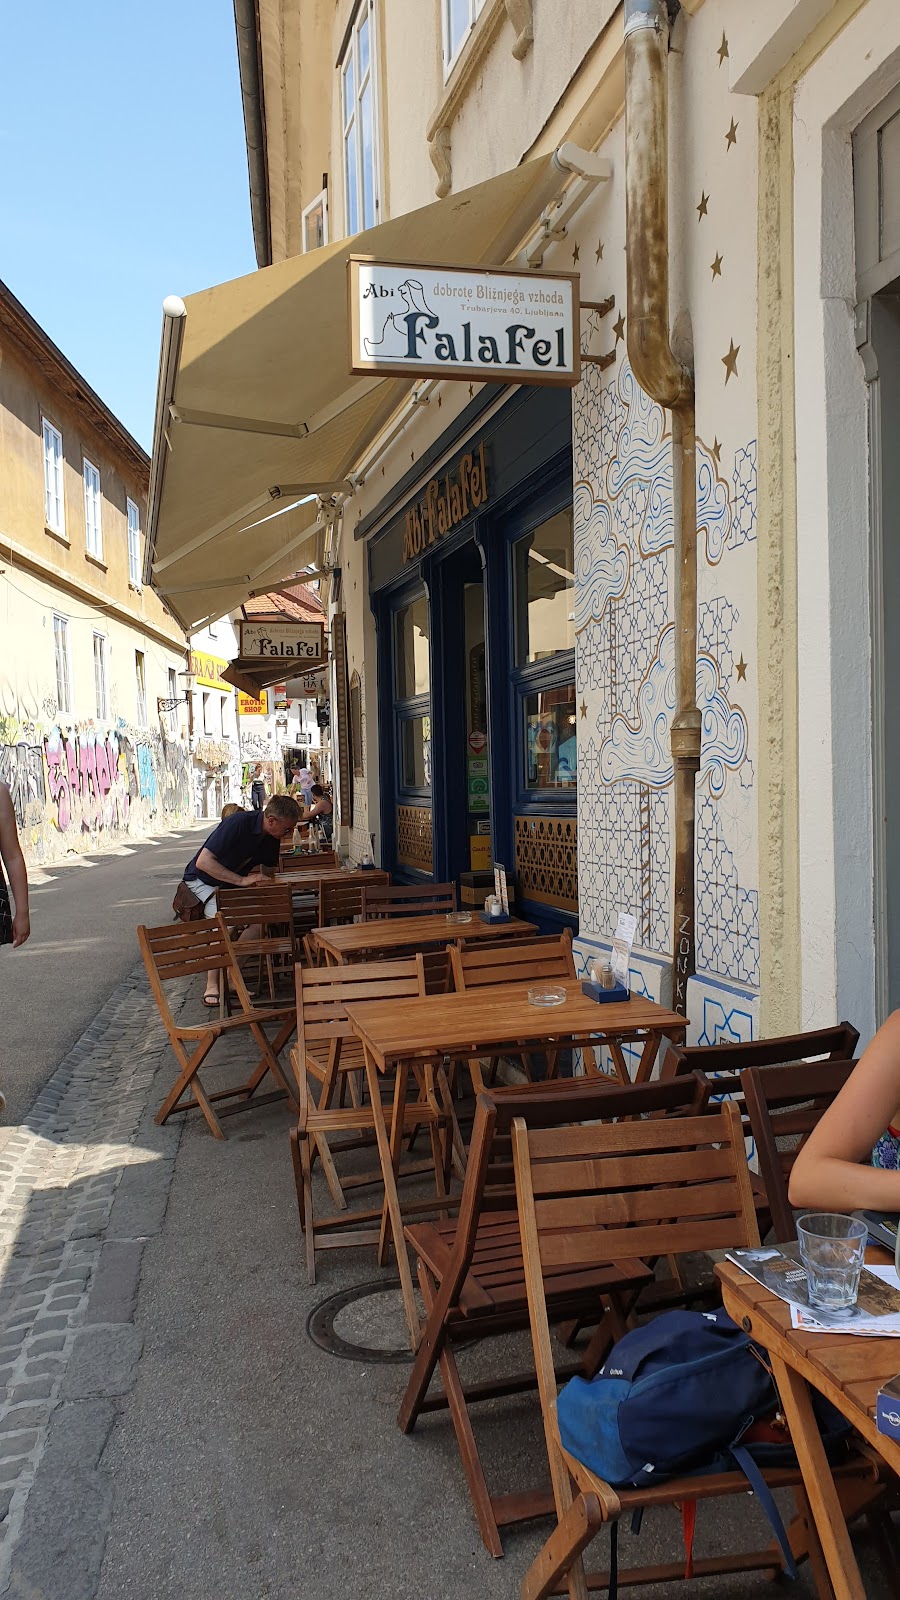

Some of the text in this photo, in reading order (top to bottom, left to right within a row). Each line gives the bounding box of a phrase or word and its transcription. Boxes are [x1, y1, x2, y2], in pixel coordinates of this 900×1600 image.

[362, 282, 395, 299] Abi
[432, 282, 565, 306] dobrote Bližnjega vzhoda
[460, 303, 508, 315] Trubarjeva
[524, 308, 565, 318] Ljubljana
[402, 501, 427, 565] Abi
[239, 698, 266, 706] EROTIC
